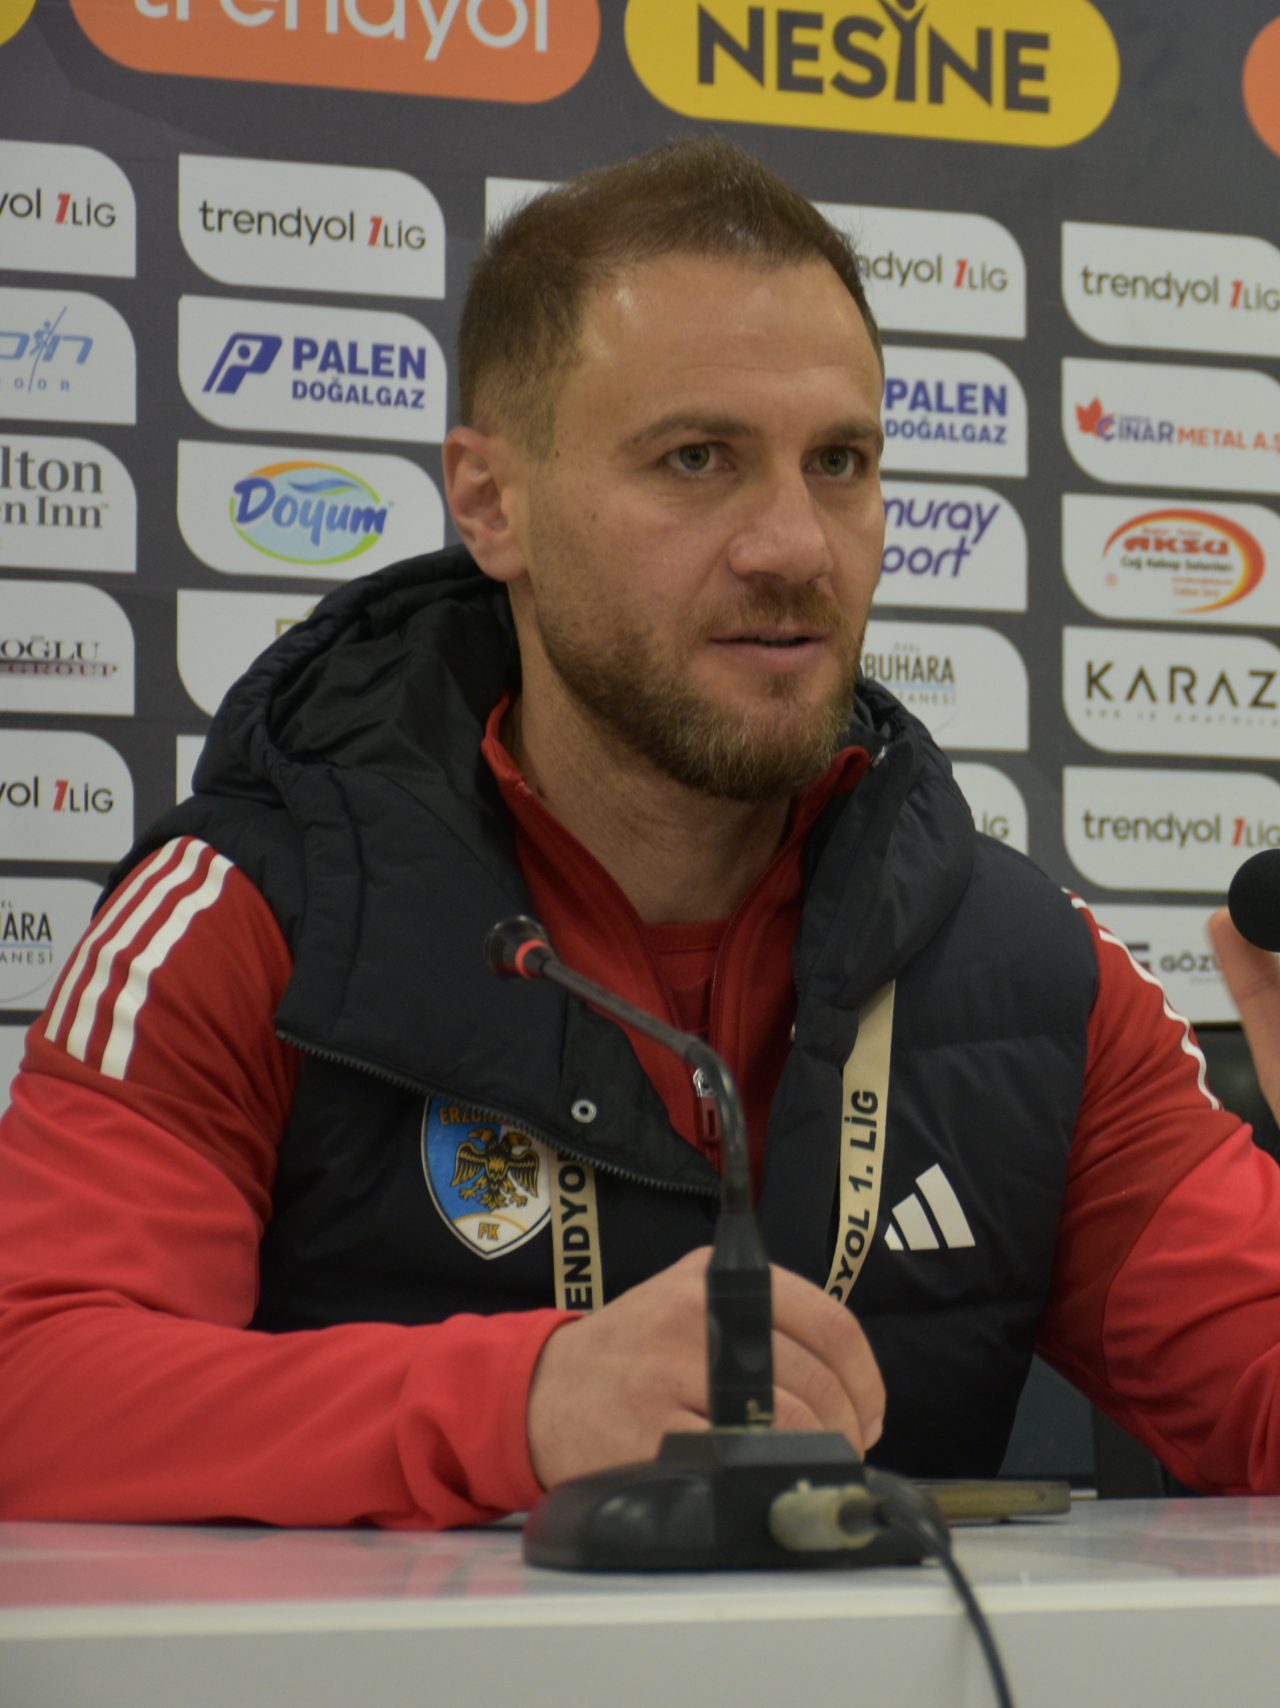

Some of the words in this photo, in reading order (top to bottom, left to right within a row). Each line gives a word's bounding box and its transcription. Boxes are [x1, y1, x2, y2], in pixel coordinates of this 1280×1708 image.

[199, 200, 355, 246] trendyol
[1081, 264, 1219, 308] trendyol
[292, 337, 426, 380] PALEN
[291, 378, 426, 410] DOĞALGAZ
[885, 377, 1008, 417] PALEN
[885, 418, 1007, 445] DOĞALGAZ
[1177, 426, 1248, 450] METAL
[233, 477, 388, 546] Doyum
[864, 653, 956, 682] BUHARA
[1085, 661, 1279, 710] KARAZ
[1083, 809, 1221, 848] trendyol
[844, 1090, 878, 1151] LİG
[477, 1221, 500, 1241] FK
